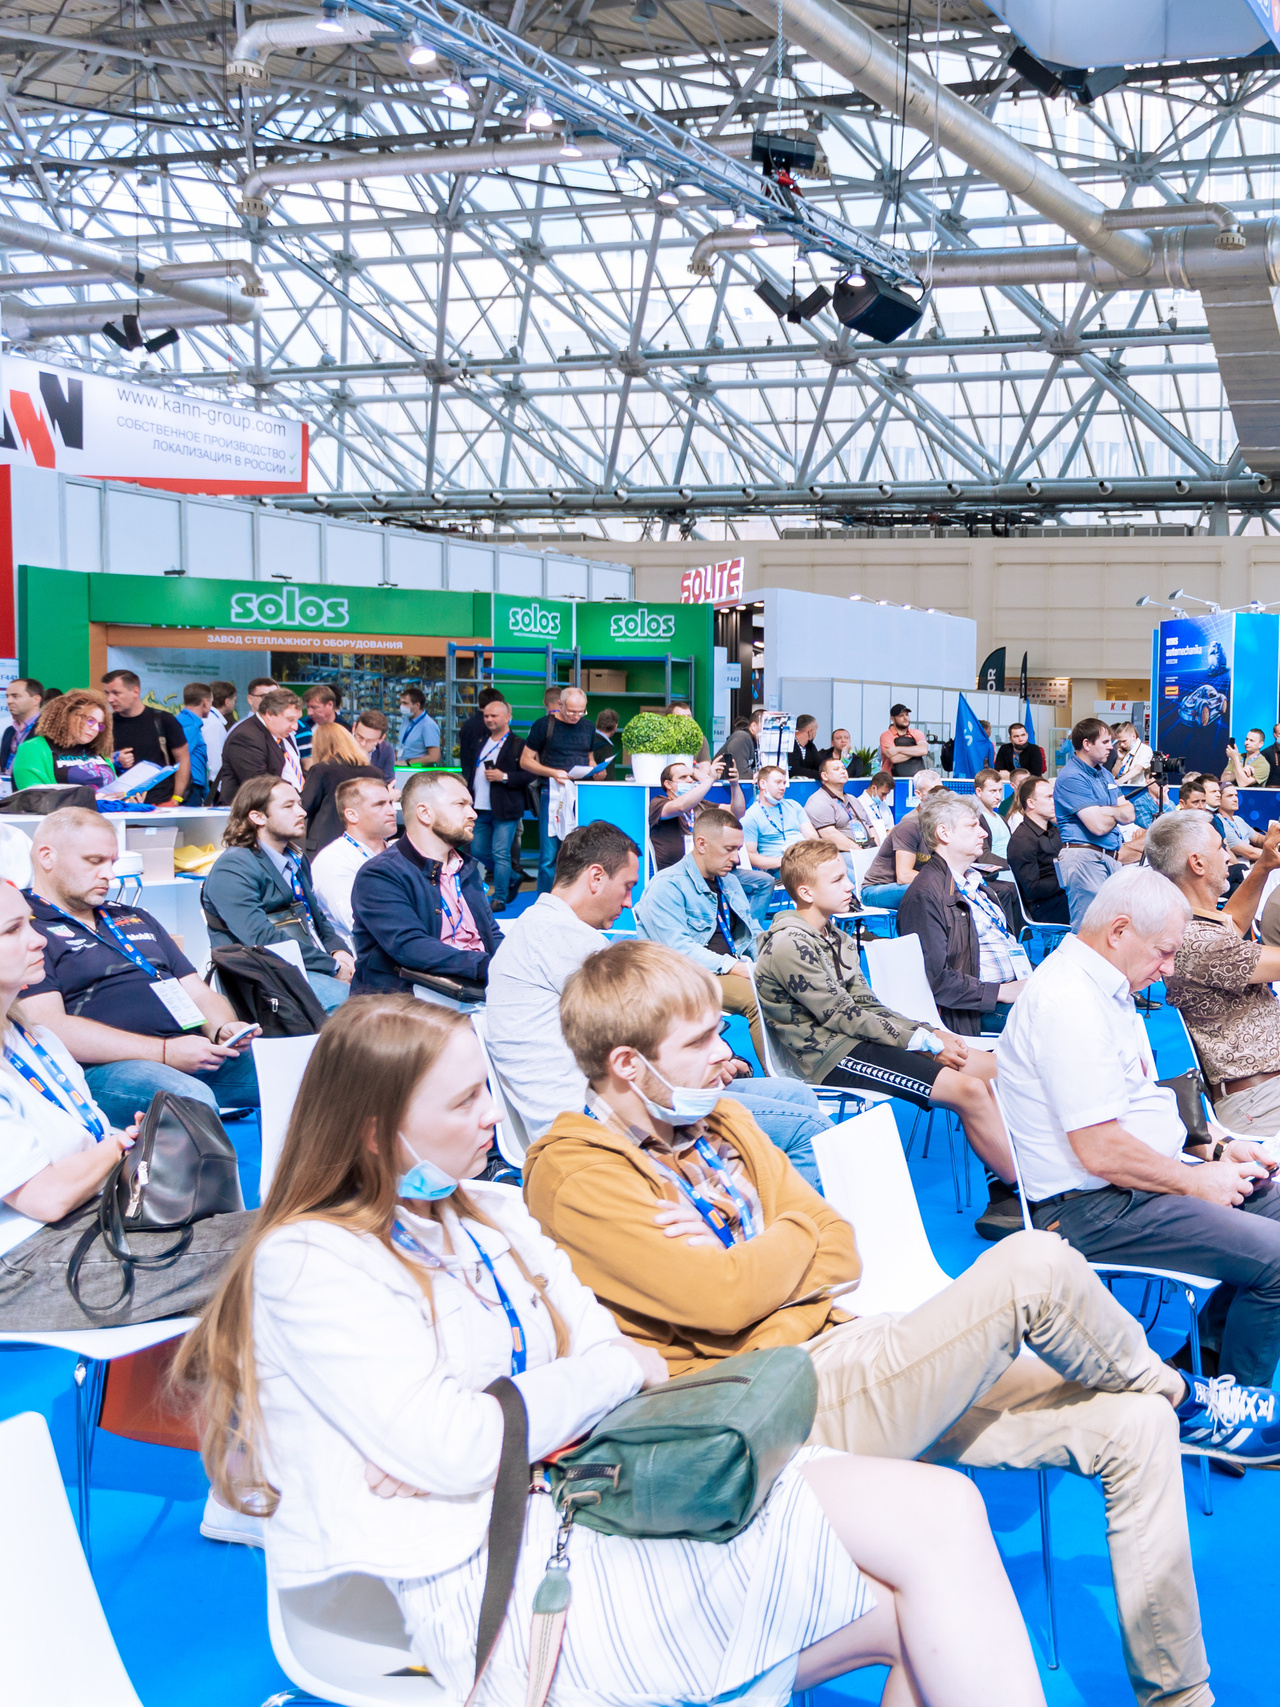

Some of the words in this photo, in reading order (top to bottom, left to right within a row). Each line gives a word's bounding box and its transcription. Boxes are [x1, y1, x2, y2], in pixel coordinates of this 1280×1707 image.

[117, 387, 286, 437] www.kann-group.com
[117, 416, 201, 443] СОБСТВЕННОЕ
[204, 434, 286, 460] ПРОИЗВОДСТВО
[152, 439, 232, 465] ЛОКАЛИЗАЦИЯ
[235, 456, 242, 466] В
[244, 457, 286, 475] РОССИИ
[680, 557, 745, 604] SOLITE
[231, 586, 350, 628] solos
[509, 603, 561, 635] solos
[610, 608, 675, 637] solos
[207, 634, 243, 645] ЗАВОД
[245, 636, 321, 647] СТЕЛЛАЖНОГО
[323, 638, 403, 649] ОБОРУДОВАНИЯ
